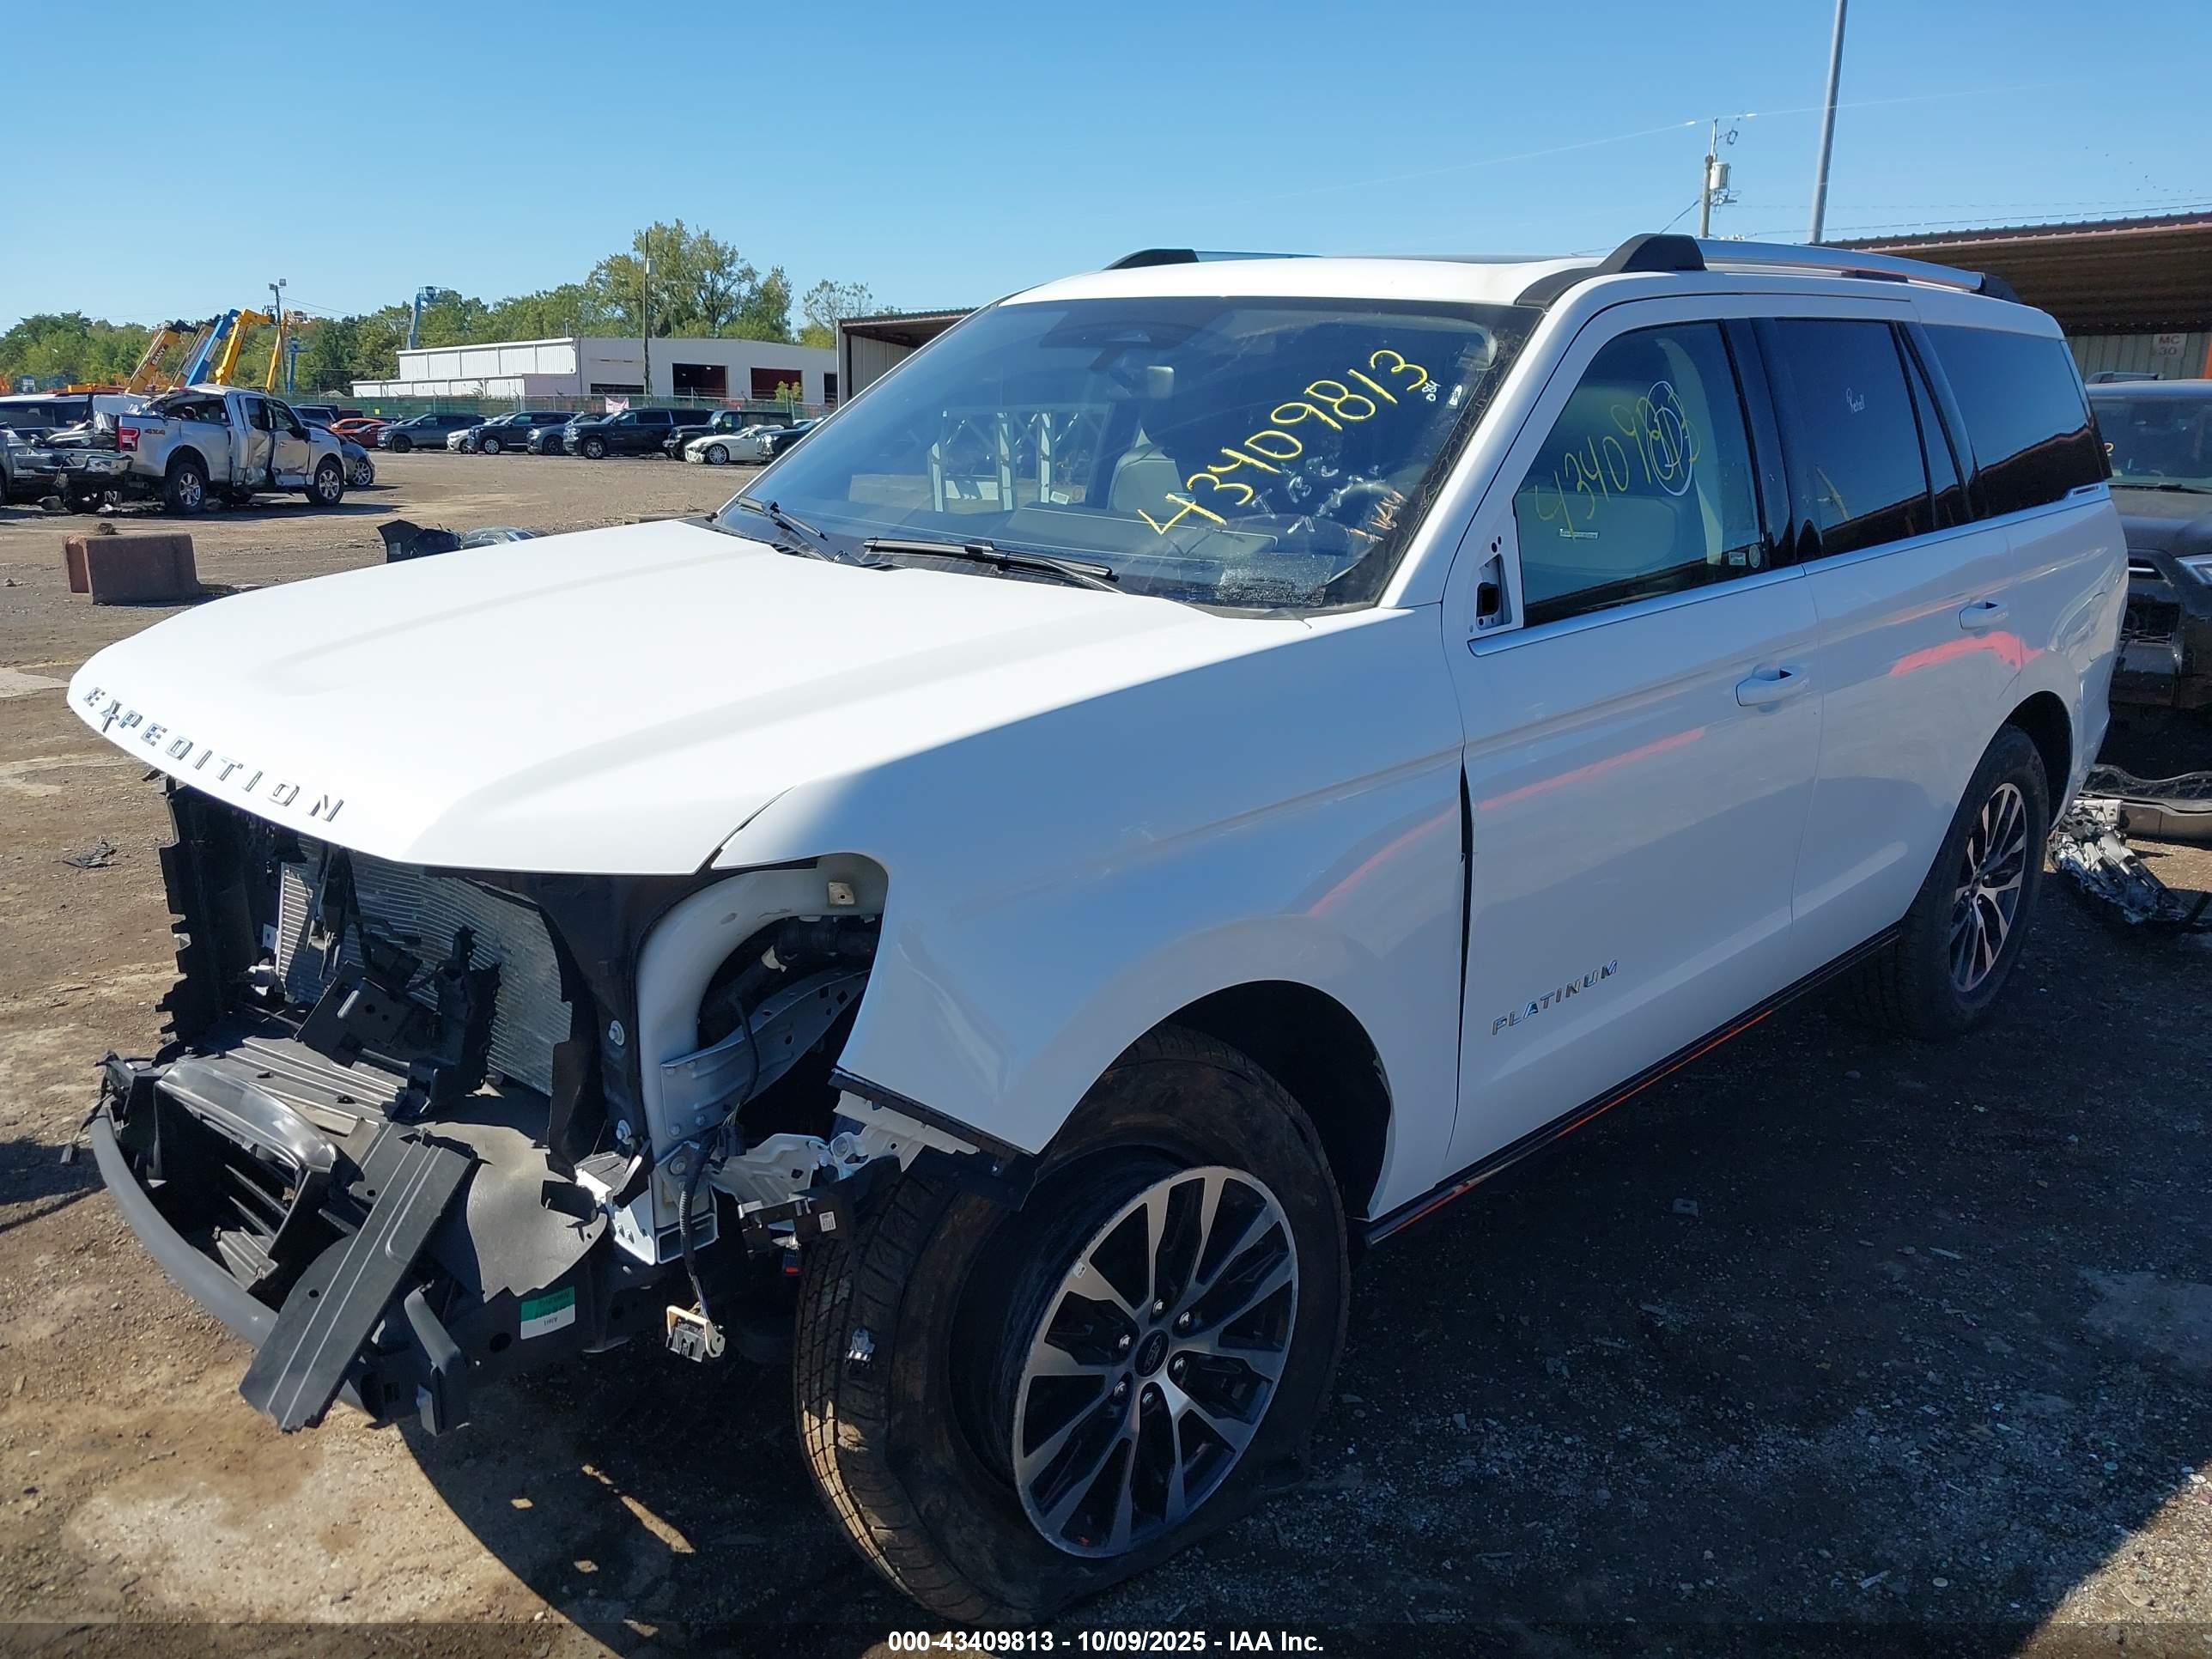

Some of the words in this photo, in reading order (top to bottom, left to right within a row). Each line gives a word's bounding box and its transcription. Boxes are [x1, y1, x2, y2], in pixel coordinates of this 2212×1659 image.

[151, 346, 165, 365] SANY
[2159, 335, 2180, 344] MC
[2159, 346, 2177, 356] 30
[1137, 349, 1428, 535] 43409813
[82, 686, 344, 823] EXPEDITION
[1492, 959, 1618, 1036] PLATINUM
